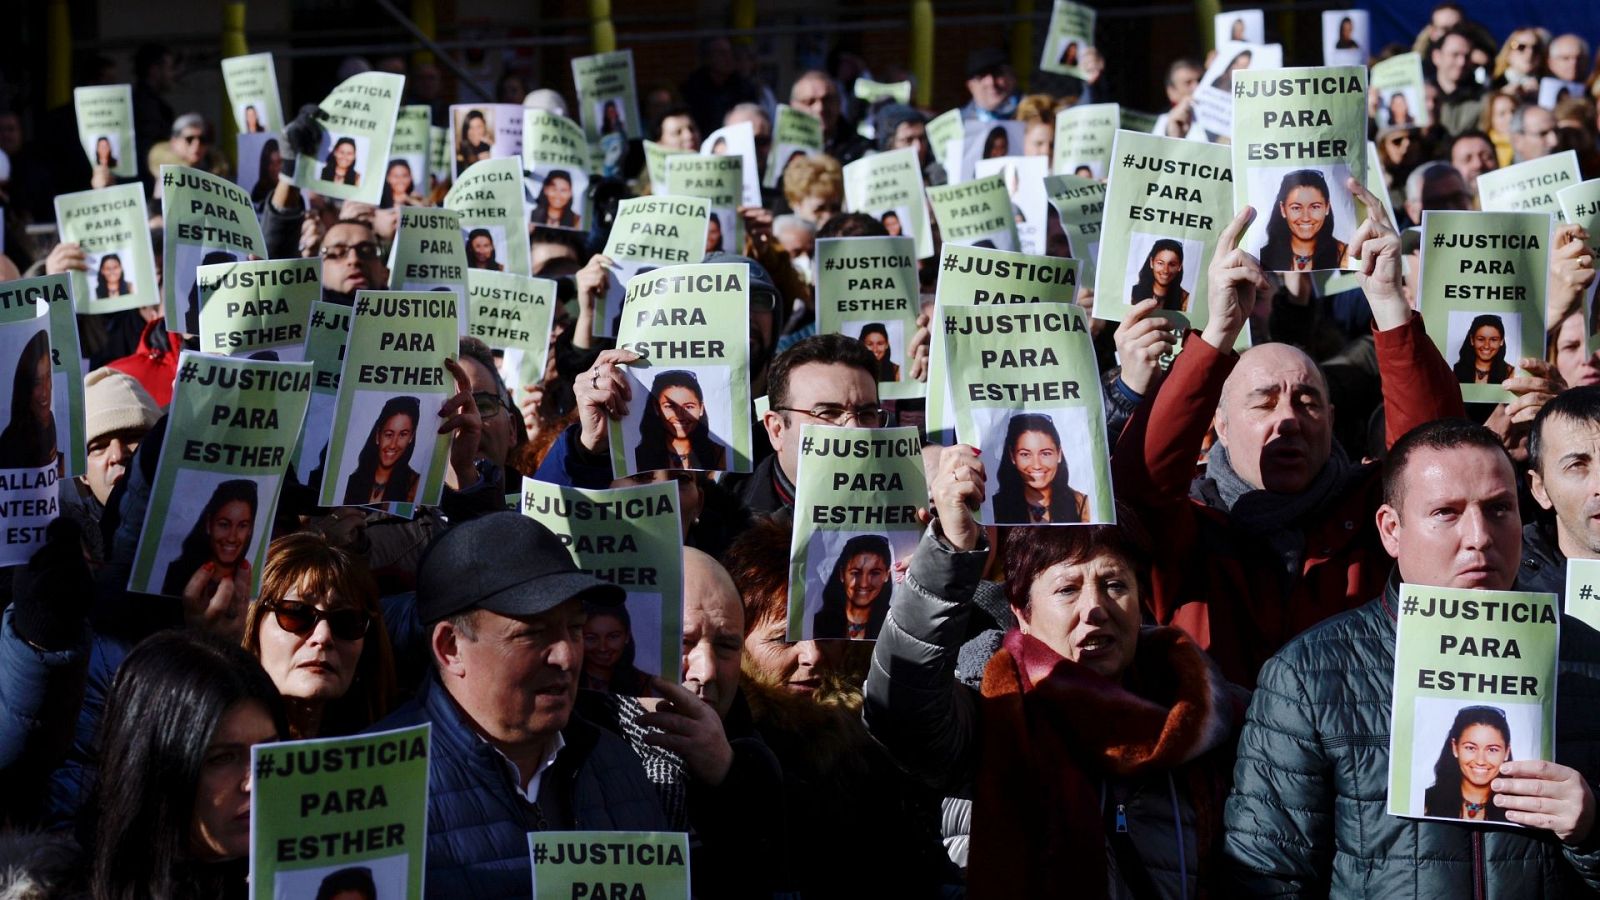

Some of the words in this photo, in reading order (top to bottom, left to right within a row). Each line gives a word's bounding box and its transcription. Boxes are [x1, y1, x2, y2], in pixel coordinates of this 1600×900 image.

[339, 85, 392, 99] STICIA
[1235, 76, 1363, 99] #JUSTICIA
[330, 115, 377, 131] STHER
[1264, 109, 1333, 129] PARA
[1248, 140, 1348, 161] ESTHER
[1123, 154, 1232, 182] #JUSTICIA
[163, 173, 253, 210] #JUSTICIA
[1147, 183, 1203, 203] PARA
[66, 198, 136, 219] #JUSTICIA
[191, 200, 240, 224] PARA
[457, 208, 506, 219] STHER
[620, 202, 707, 218] #JUSTICIA
[950, 202, 991, 219] PARA
[1130, 206, 1213, 231] ESTHER
[85, 217, 122, 232] PARA
[630, 222, 679, 238] PARA
[948, 217, 1005, 238] ESTHER
[80, 231, 132, 249] ESTHER
[178, 223, 254, 251] ESTHER
[420, 239, 454, 254] PARA
[1433, 233, 1540, 250] #JUSTICIA
[615, 244, 690, 262] ESTHER
[825, 255, 912, 271] #JUSTICIA
[406, 264, 462, 280] ESTHER
[943, 254, 1076, 286] #JUSTICIA
[1460, 260, 1516, 275] PARA
[200, 267, 318, 292] #JUSTICIA
[626, 274, 742, 304] #JUSTICIA
[848, 277, 895, 291] PARA
[470, 285, 545, 306] JUSTICIA
[1444, 285, 1527, 301] ESTHER
[227, 298, 289, 318] PARA
[355, 297, 458, 319] #JUSTICIA
[479, 306, 522, 321] PARA
[837, 298, 908, 313] ESTHER
[636, 308, 707, 328] PARA
[945, 313, 1087, 335] #JUSTICIA
[215, 324, 302, 348] ESTHER
[380, 332, 435, 352] PARA
[981, 347, 1059, 368] PARA
[180, 362, 311, 392] #JUSTICIA
[359, 364, 444, 385] ESTHER
[968, 381, 1080, 402] ESTHER
[211, 405, 279, 430] PARA
[184, 440, 285, 467] ESTHER
[802, 437, 922, 458] #JUSTICIA
[833, 472, 904, 491] PARA
[525, 491, 674, 520] #JUSTICIA
[813, 505, 917, 524] ESTHER
[1403, 596, 1557, 624] #JUSTICIA
[1440, 635, 1521, 659] PARA
[1418, 669, 1538, 696] ESTHER
[257, 737, 426, 779] #JUSTICIA
[301, 785, 388, 817] PARA
[277, 823, 405, 862] ESTHER
[534, 843, 684, 865] #JUSTICIA
[572, 882, 646, 900] PARA
